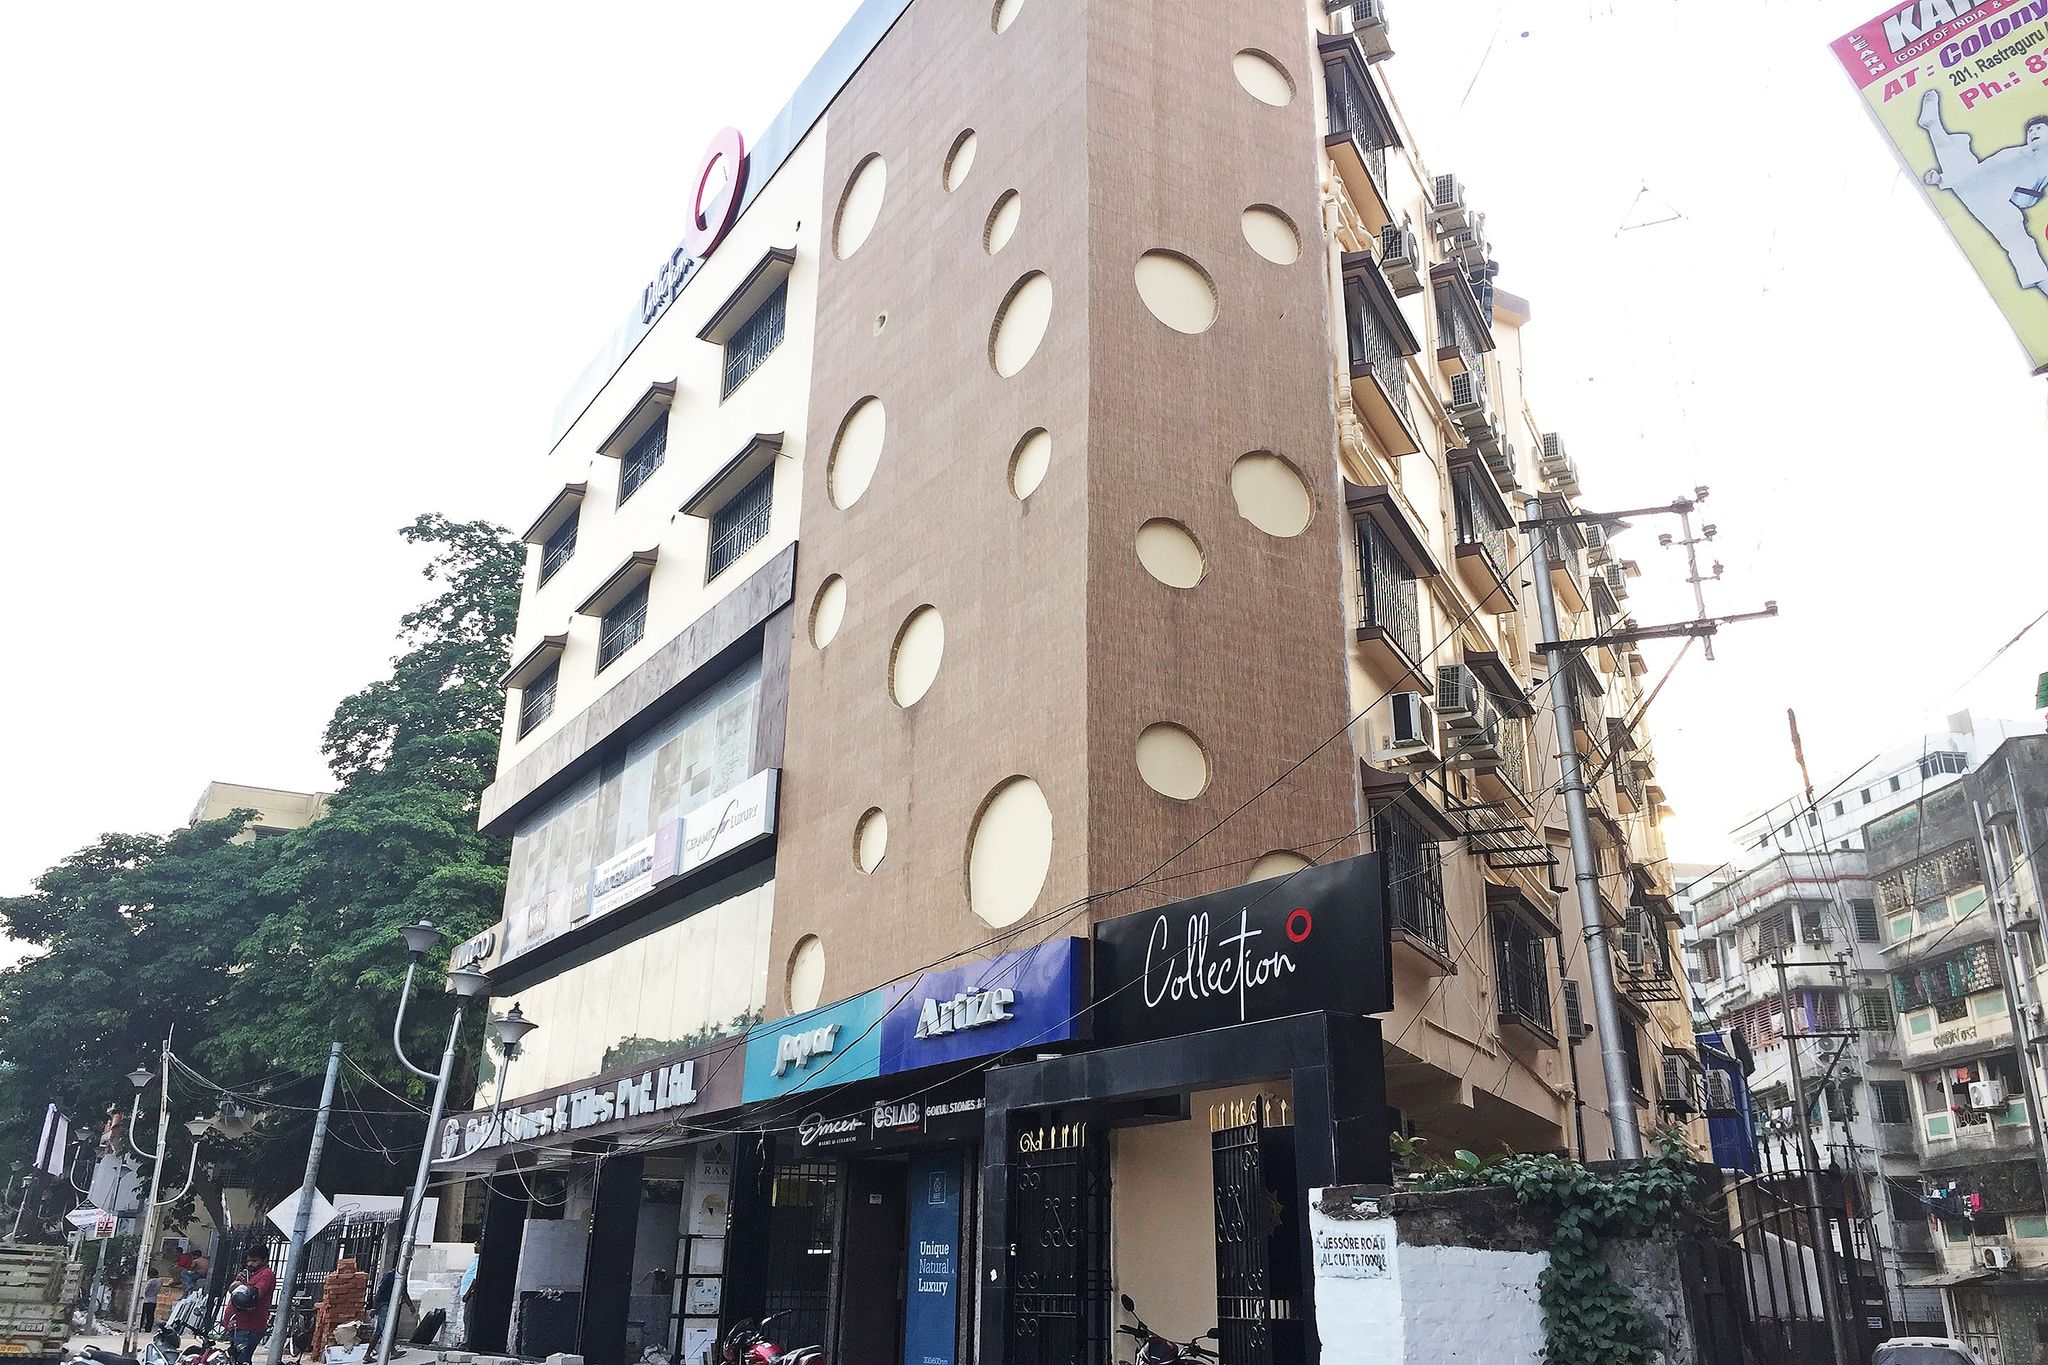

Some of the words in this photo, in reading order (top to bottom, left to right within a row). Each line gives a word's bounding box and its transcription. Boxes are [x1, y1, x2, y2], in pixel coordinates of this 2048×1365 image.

[1939, 0, 2048, 68] Colony
[1952, 10, 1988, 30] INDIA
[1848, 35, 1887, 76] LEARN
[1949, 66, 1978, 87] 201,
[1975, 29, 2045, 72] Rastraguru
[686, 827, 716, 851] CERAMIC
[730, 804, 759, 829] LUXURY
[1144, 906, 1296, 1021] Collection
[913, 986, 1014, 1039] Artize
[553, 1094, 568, 1133] &
[950, 1099, 976, 1113] STONES
[704, 1166, 729, 1175] RAK
[920, 1240, 949, 1258] Unique
[1323, 1236, 1360, 1250] JESSORE
[1360, 1236, 1387, 1250] ROAD
[919, 1259, 949, 1274] Natural
[918, 1278, 948, 1296] Luxury
